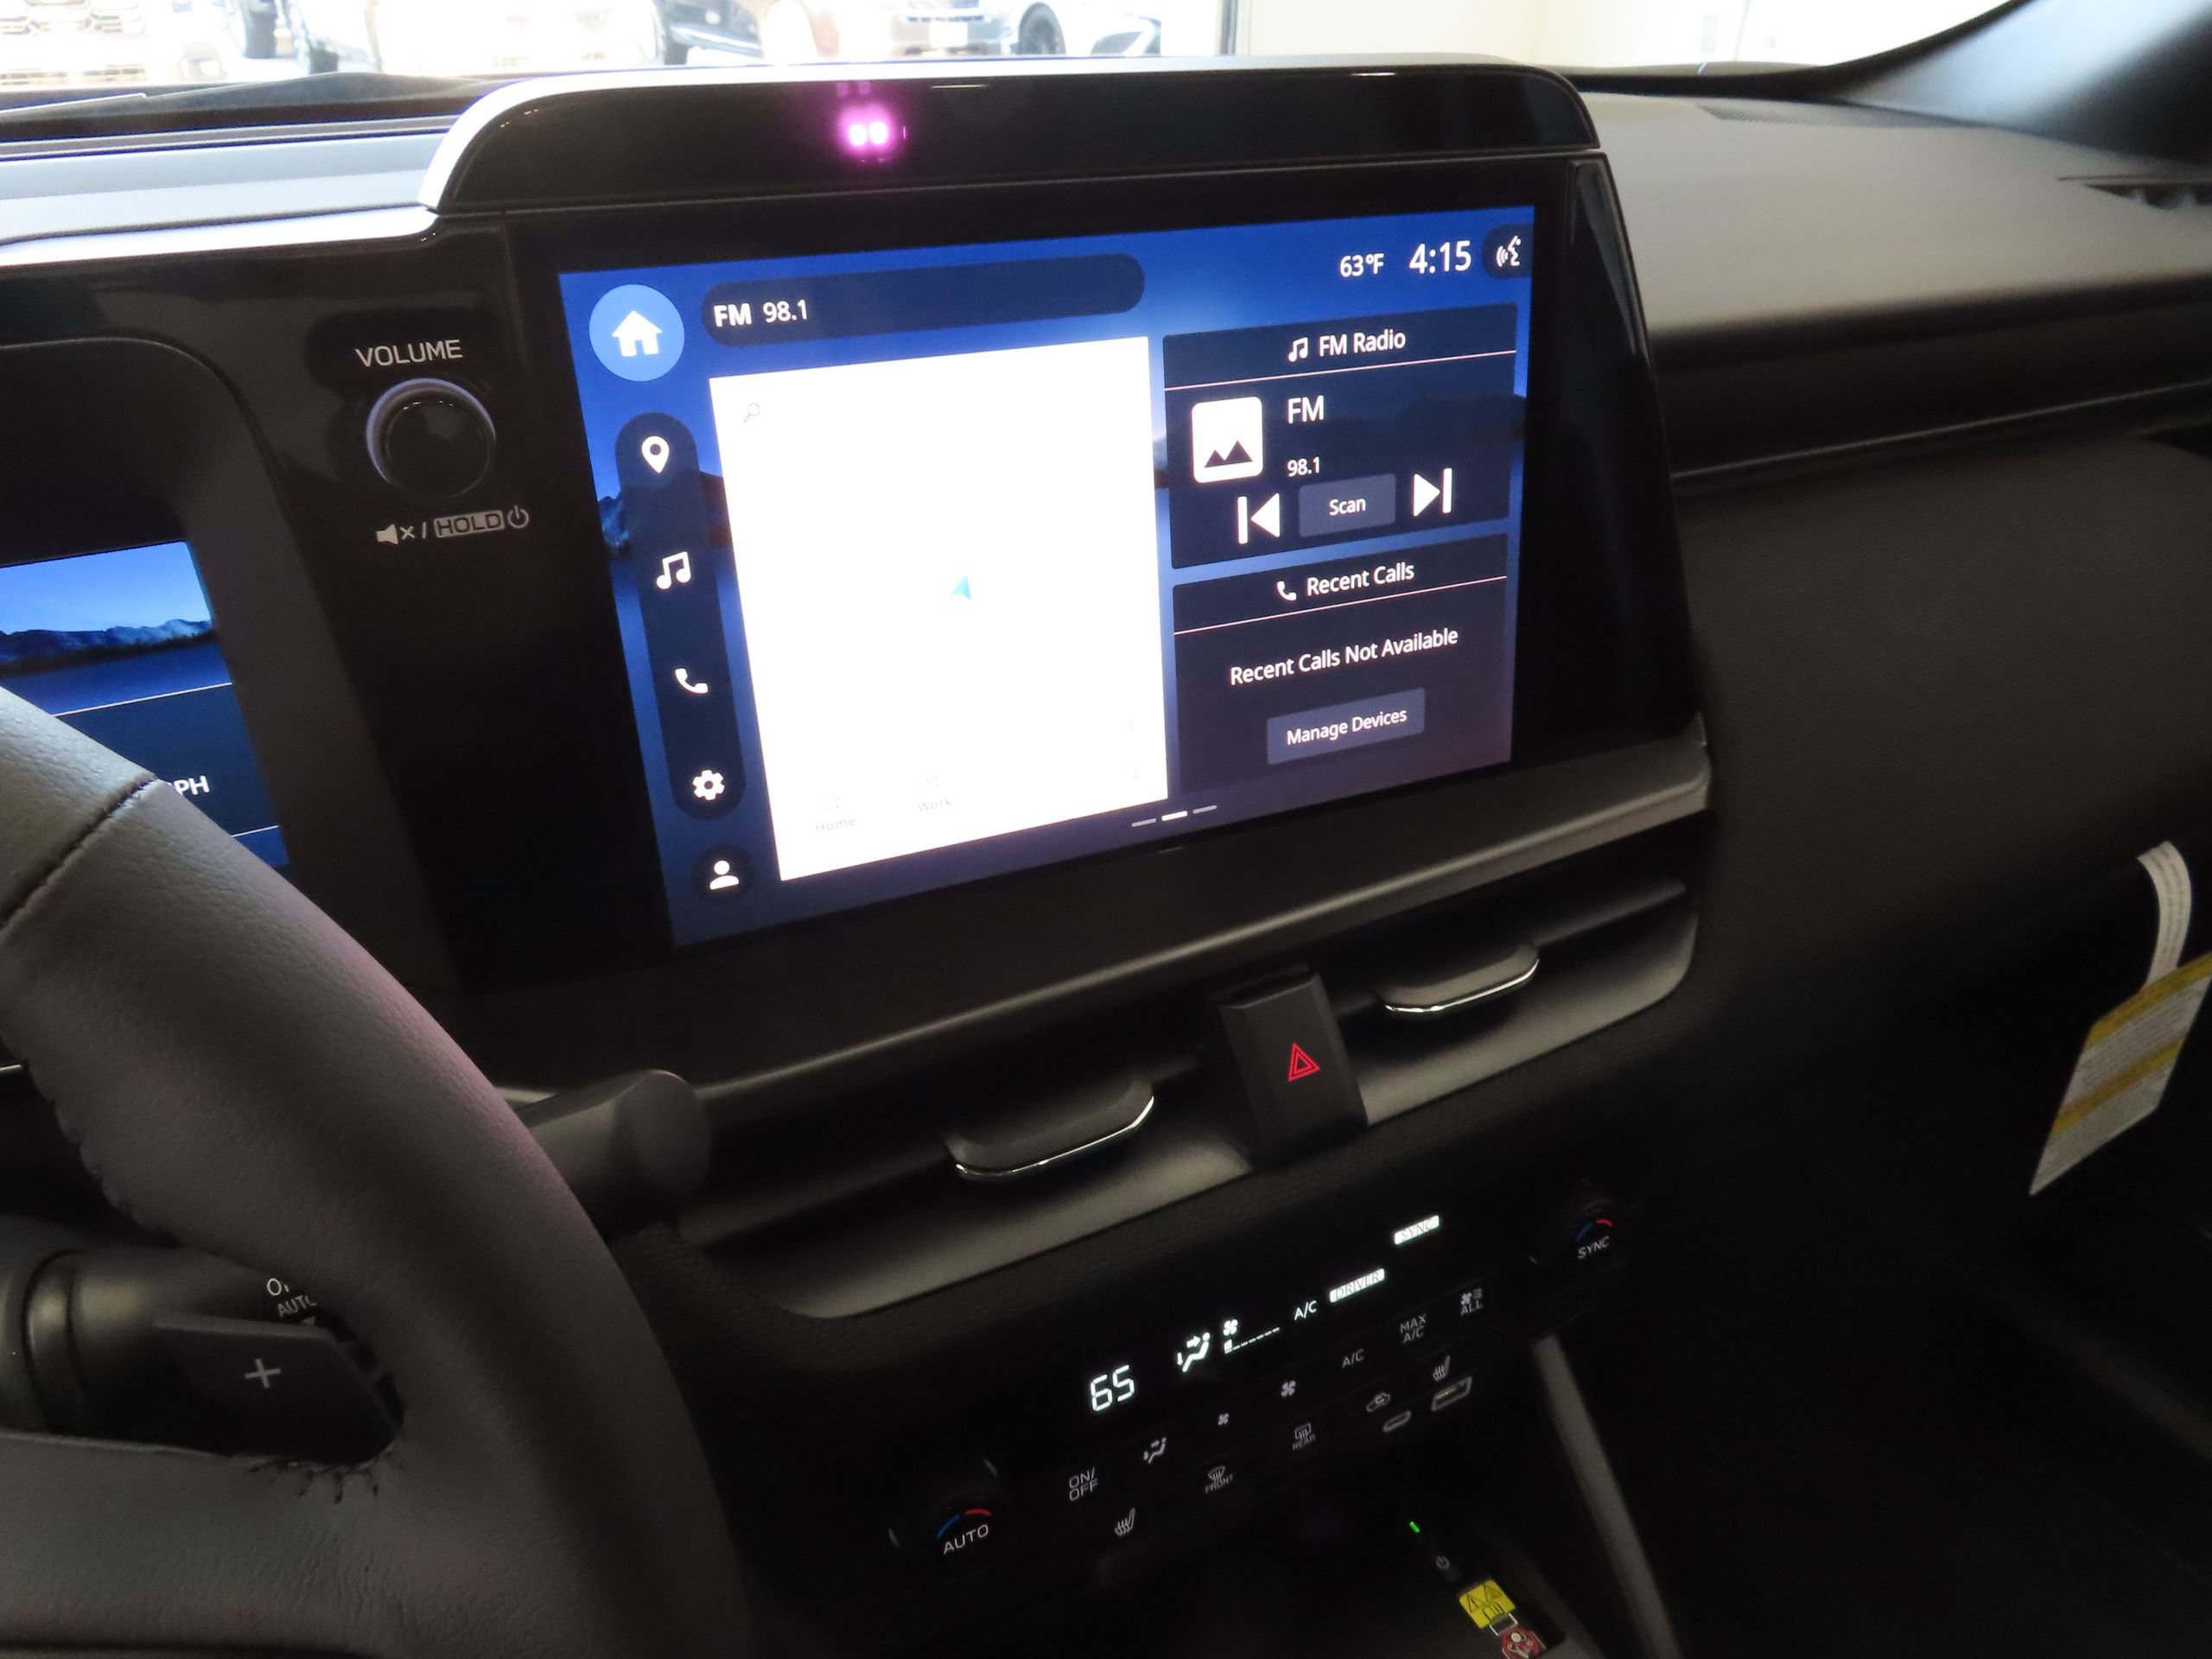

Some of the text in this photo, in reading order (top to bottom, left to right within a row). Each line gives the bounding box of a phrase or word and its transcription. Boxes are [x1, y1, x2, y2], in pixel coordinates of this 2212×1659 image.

[1408, 240, 1471, 274] 4:15
[713, 298, 808, 327] FM 98.1
[355, 339, 463, 367] VOLUME
[1319, 329, 1407, 357] FM Radio
[1287, 395, 1325, 424] FM
[1287, 456, 1320, 477] 98.1
[1329, 496, 1366, 517] Scan
[435, 512, 504, 537] HOLD
[1306, 562, 1415, 597] Recent Calls
[1230, 626, 1459, 685] Recent Calls Not Available
[1286, 708, 1408, 746] Manage Devices
[170, 775, 211, 796] PH
[917, 797, 952, 813] Work
[815, 816, 856, 833] Home
[1400, 1218, 1433, 1241] SYNC
[1578, 1236, 1611, 1259] SYNC
[266, 1278, 289, 1296] O
[1334, 1270, 1380, 1300] DRIVER
[1294, 1300, 1318, 1321] A/C
[1460, 1299, 1483, 1316] ALL
[1400, 1313, 1426, 1333] MAX
[1403, 1326, 1424, 1344] A/C
[1342, 1348, 1364, 1368] A/C
[1090, 1364, 1135, 1411] 65
[1069, 1466, 1095, 1489] ON/
[1069, 1478, 1098, 1502] OFF
[943, 1523, 989, 1554] AUTO
